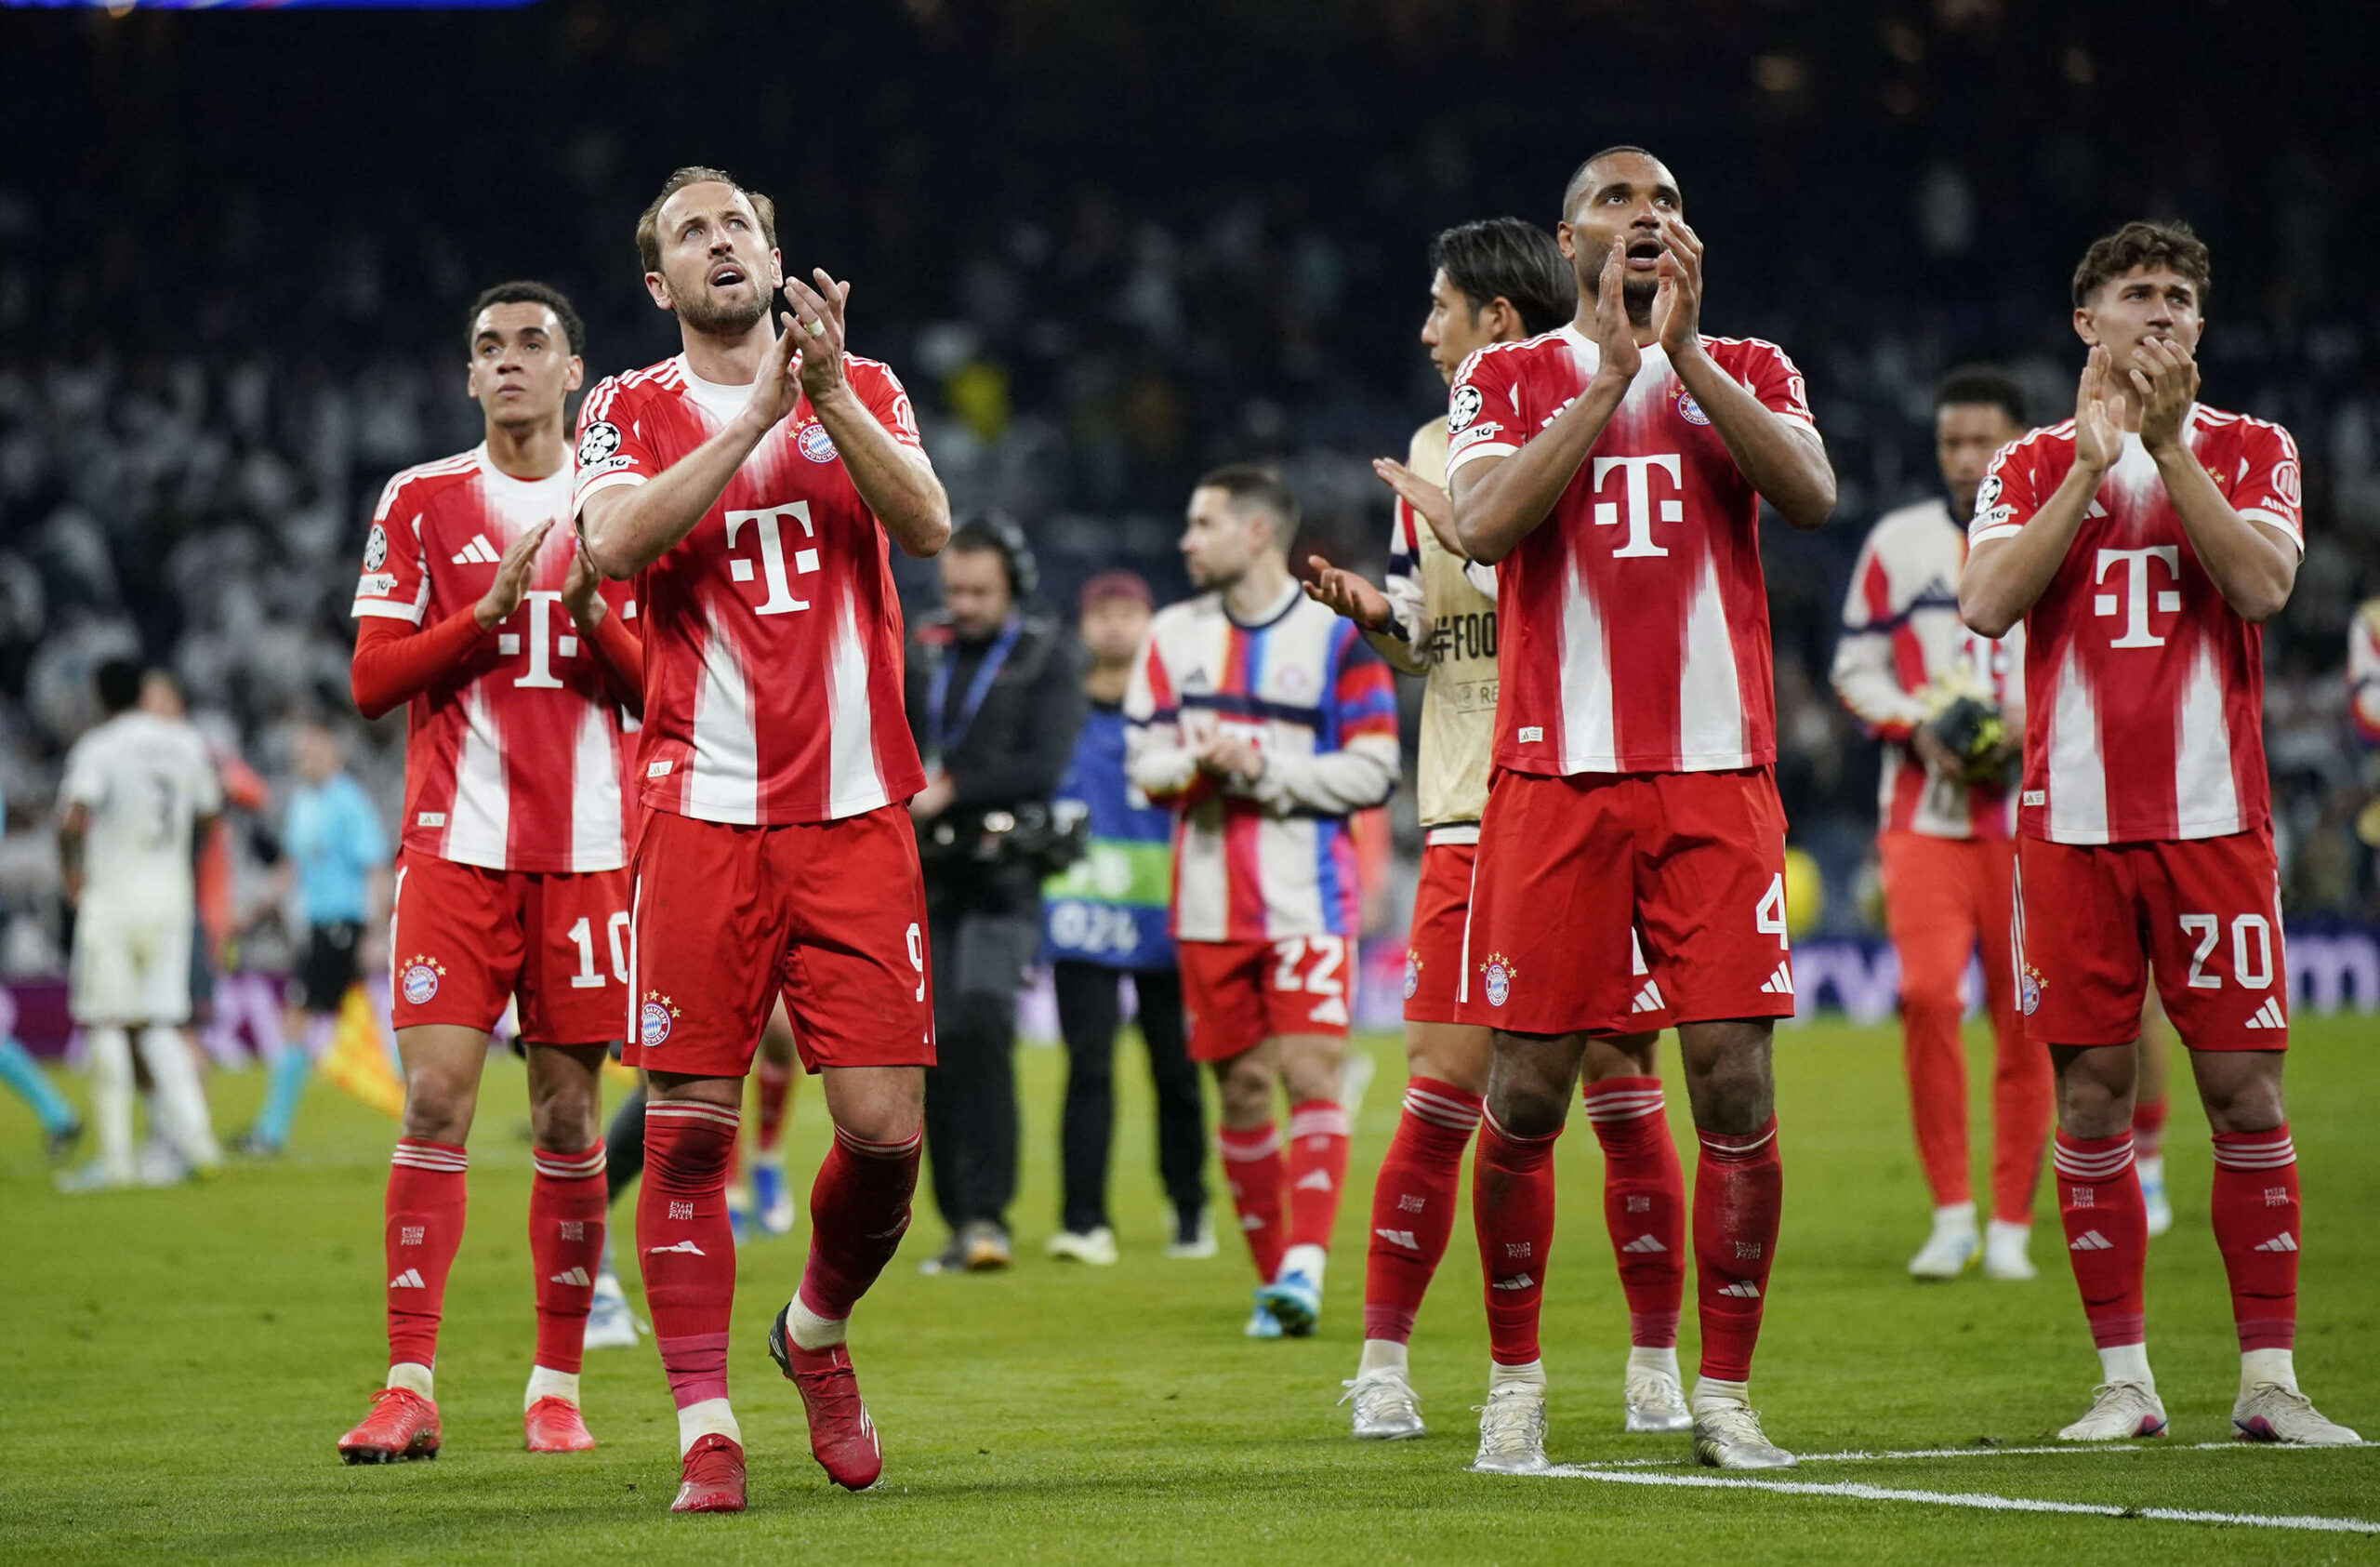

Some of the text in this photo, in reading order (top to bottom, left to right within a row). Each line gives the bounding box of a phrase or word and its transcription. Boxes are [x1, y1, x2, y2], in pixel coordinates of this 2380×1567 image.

[1475, 428, 1492, 437] 10
[1593, 454, 1684, 558] T
[724, 499, 821, 615] T
[2095, 545, 2181, 648] T
[567, 910, 631, 989] 10
[1755, 872, 1789, 950] 4
[906, 923, 925, 1003] 9
[1275, 933, 1344, 995] 22
[2179, 914, 2273, 989] 20
